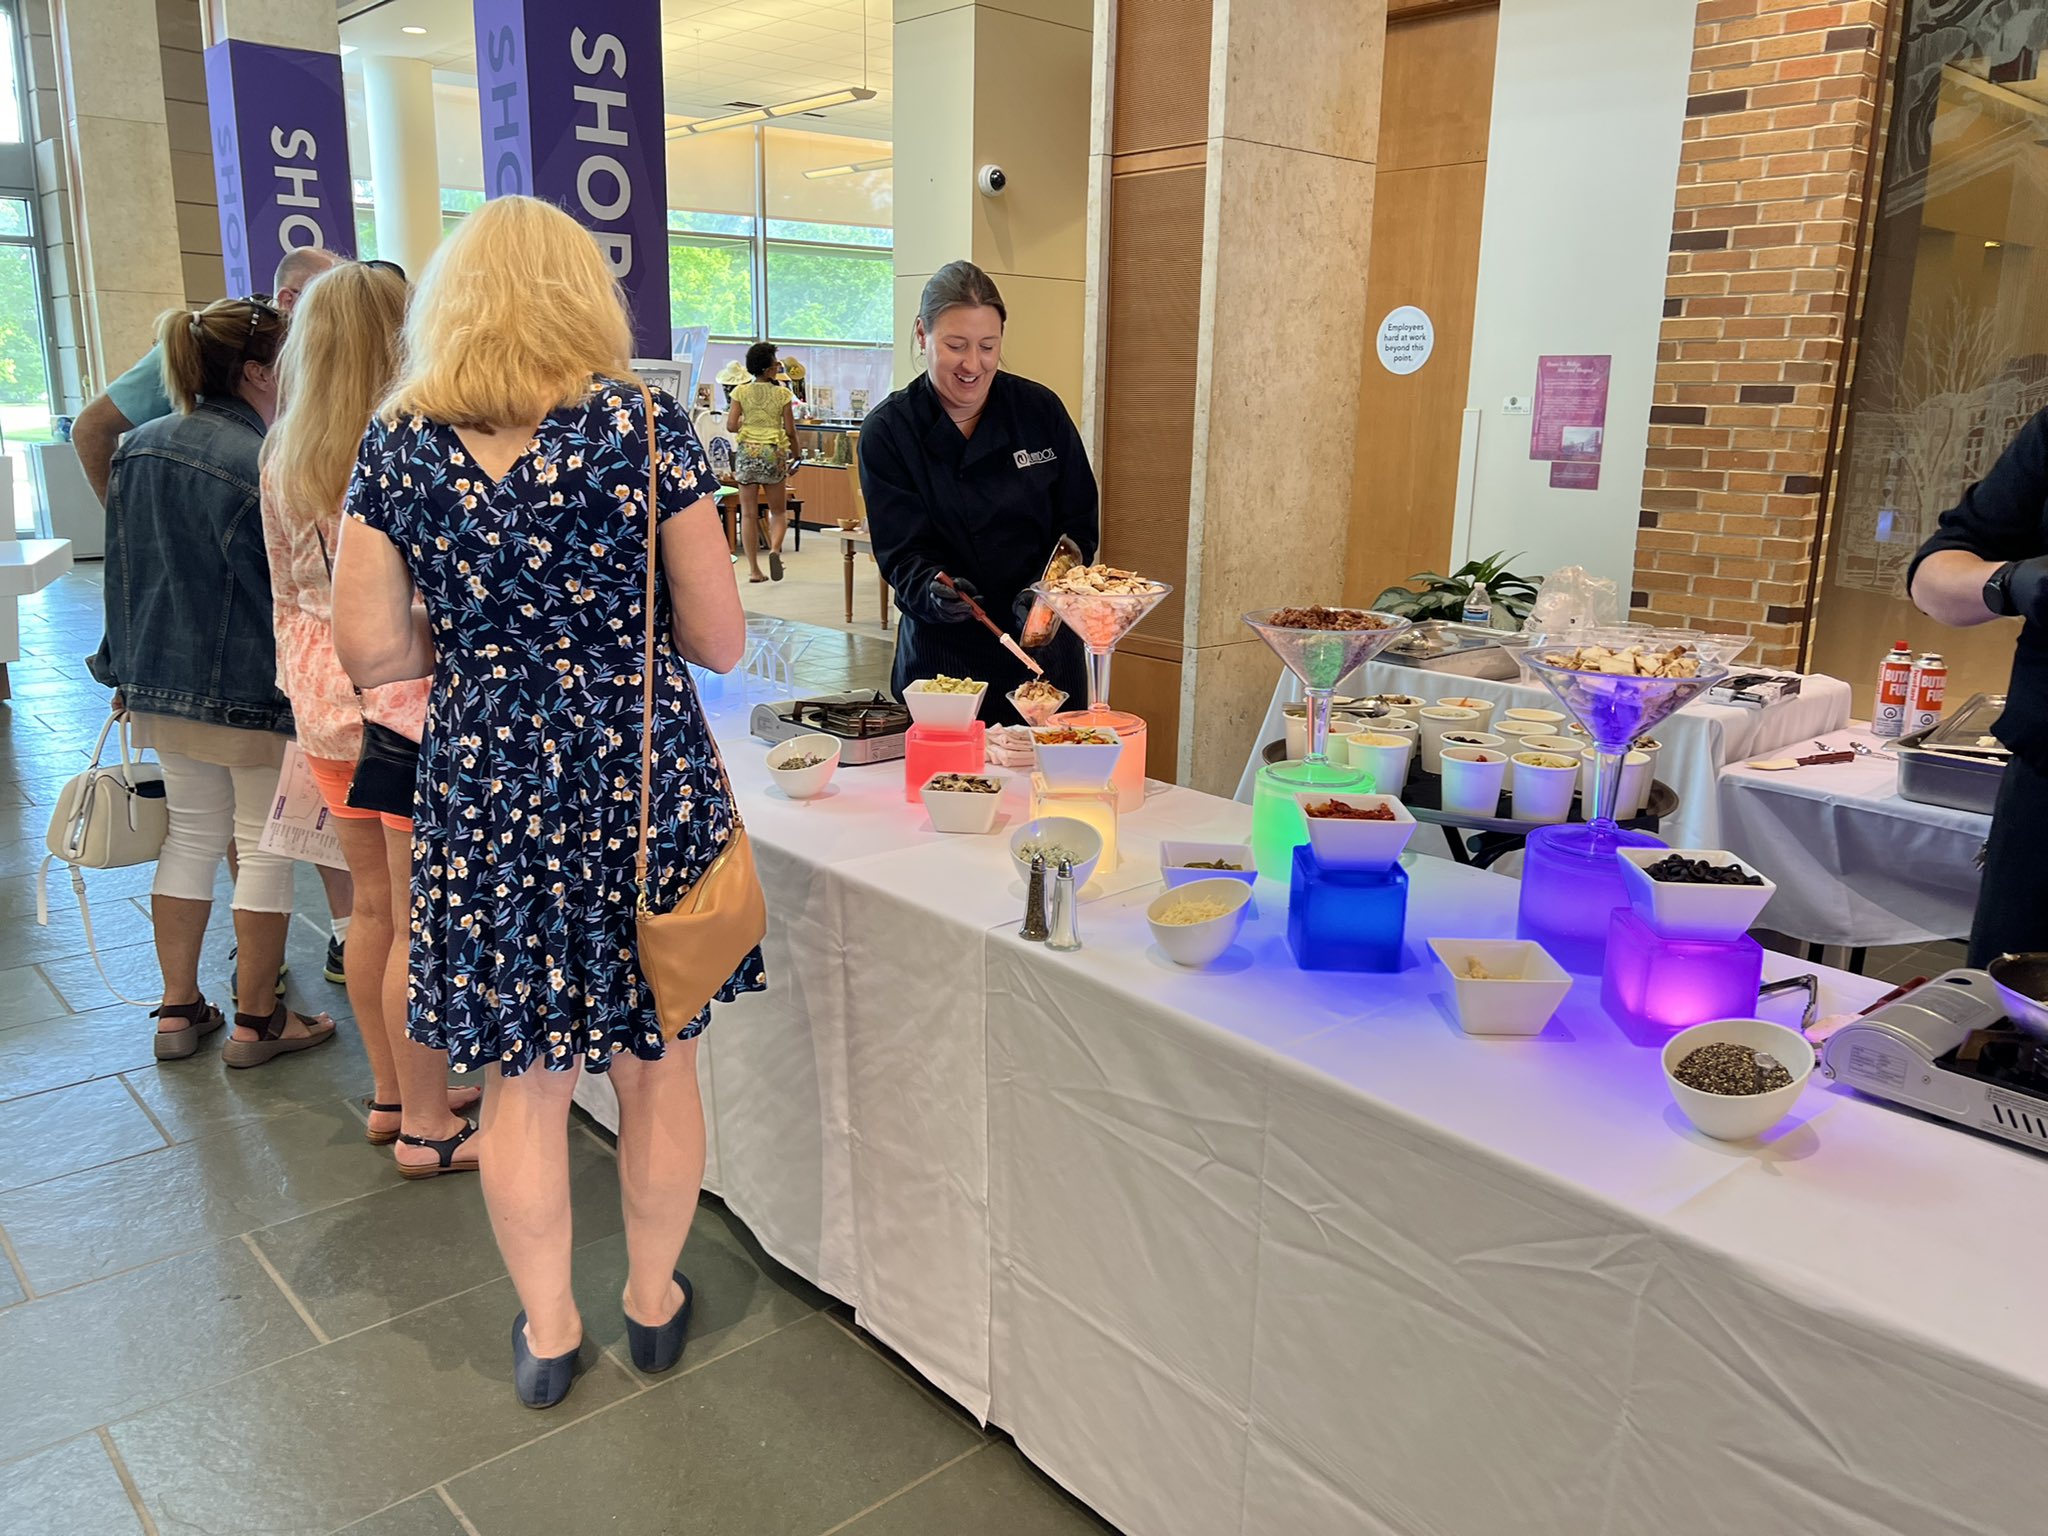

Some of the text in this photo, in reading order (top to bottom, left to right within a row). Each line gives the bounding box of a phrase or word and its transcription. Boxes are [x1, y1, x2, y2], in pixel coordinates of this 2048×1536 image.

[488, 25, 522, 198] SHO
[570, 26, 632, 278] SHOP
[270, 125, 324, 254] SHO
[217, 125, 246, 297] SHOP
[1388, 323, 1424, 332] Employees
[1384, 333, 1399, 341] hard
[1409, 333, 1426, 341] work
[1385, 344, 1410, 353] beyond
[1393, 354, 1413, 363] point.
[1885, 669, 1909, 682] BUTA
[1921, 675, 1946, 688] BUTA
[1889, 683, 1907, 696] FUE
[1926, 690, 1943, 702] FUE
